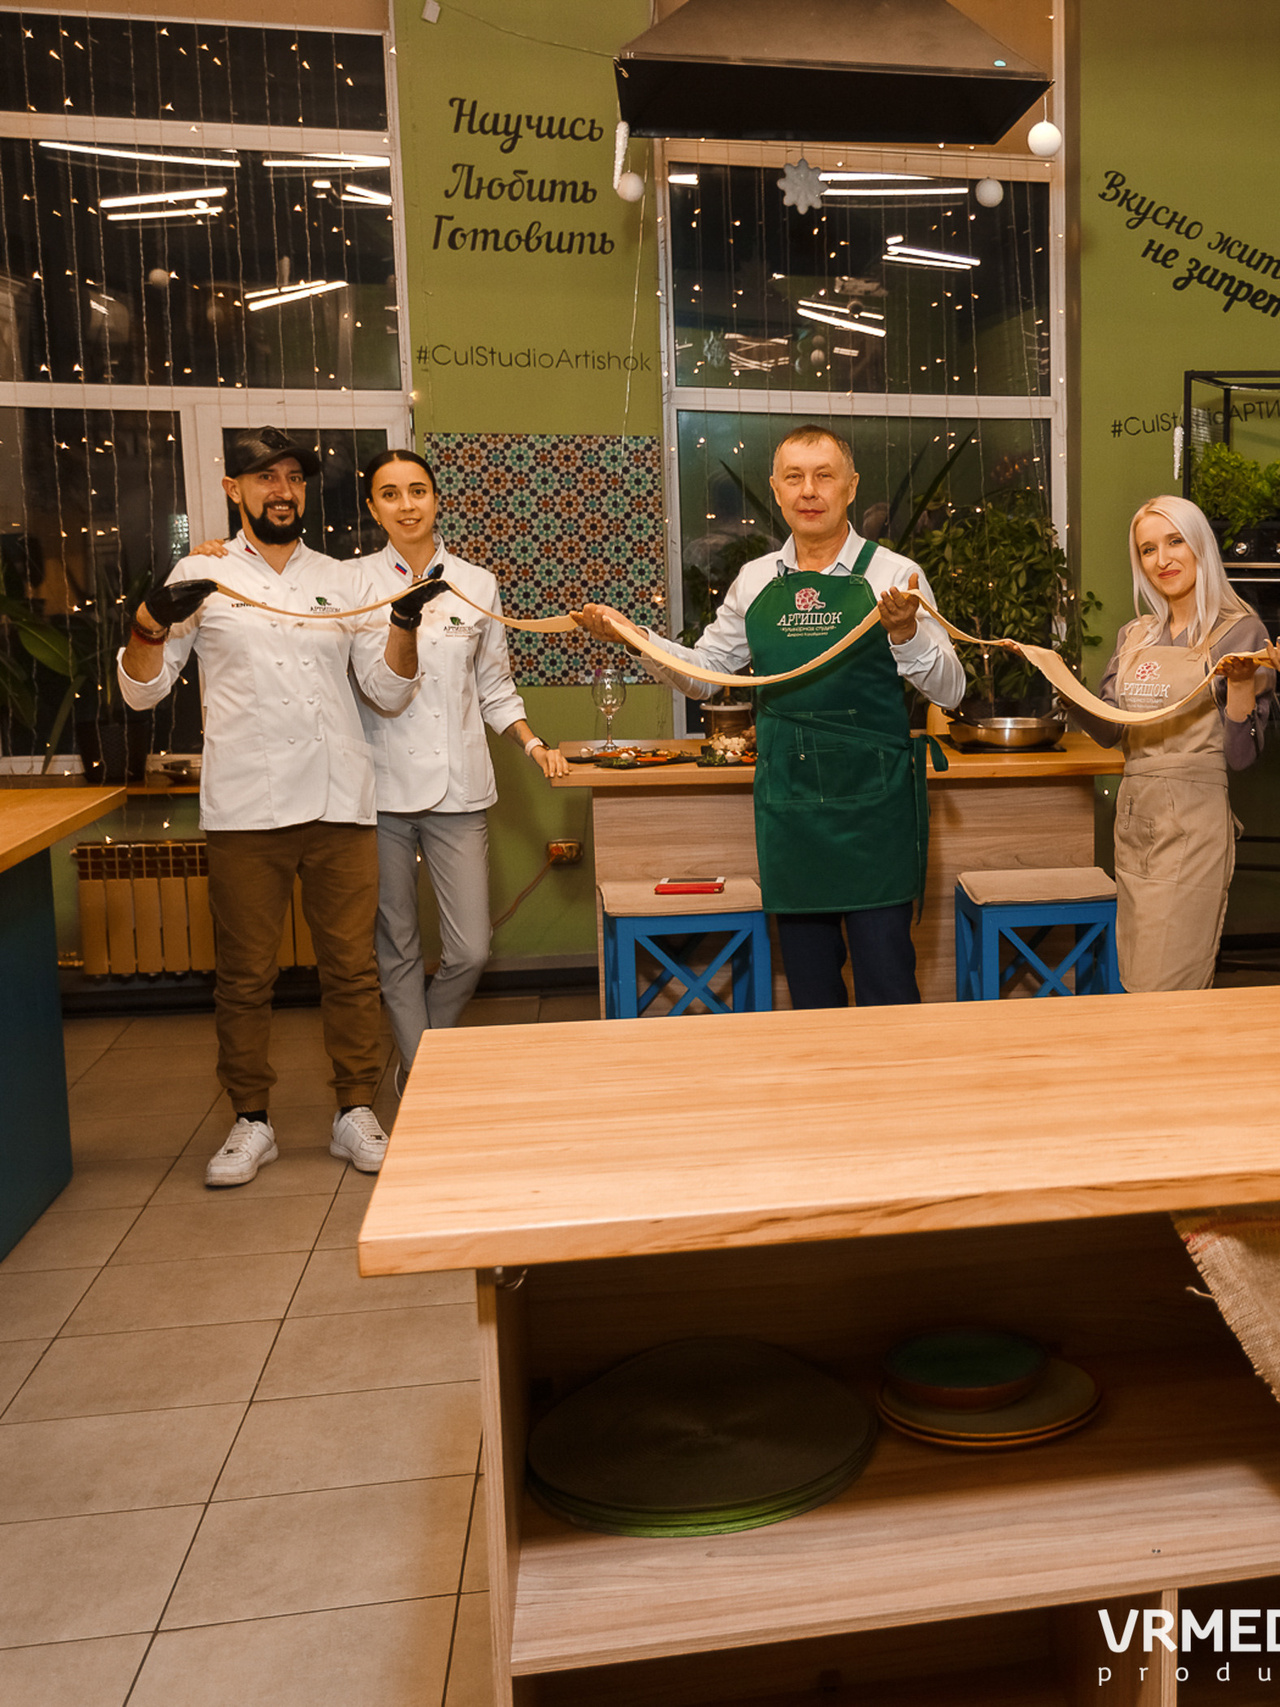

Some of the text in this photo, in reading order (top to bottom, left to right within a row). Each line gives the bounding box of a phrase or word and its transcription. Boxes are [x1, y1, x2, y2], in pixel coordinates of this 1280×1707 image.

[448, 97, 604, 153] Научись
[444, 163, 598, 204] Любить
[1098, 170, 1204, 240] Вкусно
[432, 214, 615, 255] Готовить
[1140, 239, 1180, 269] не
[416, 344, 651, 371] #CulStudioArtishok
[776, 611, 843, 626] АРТИШОК
[1119, 682, 1171, 698] РТИШОК
